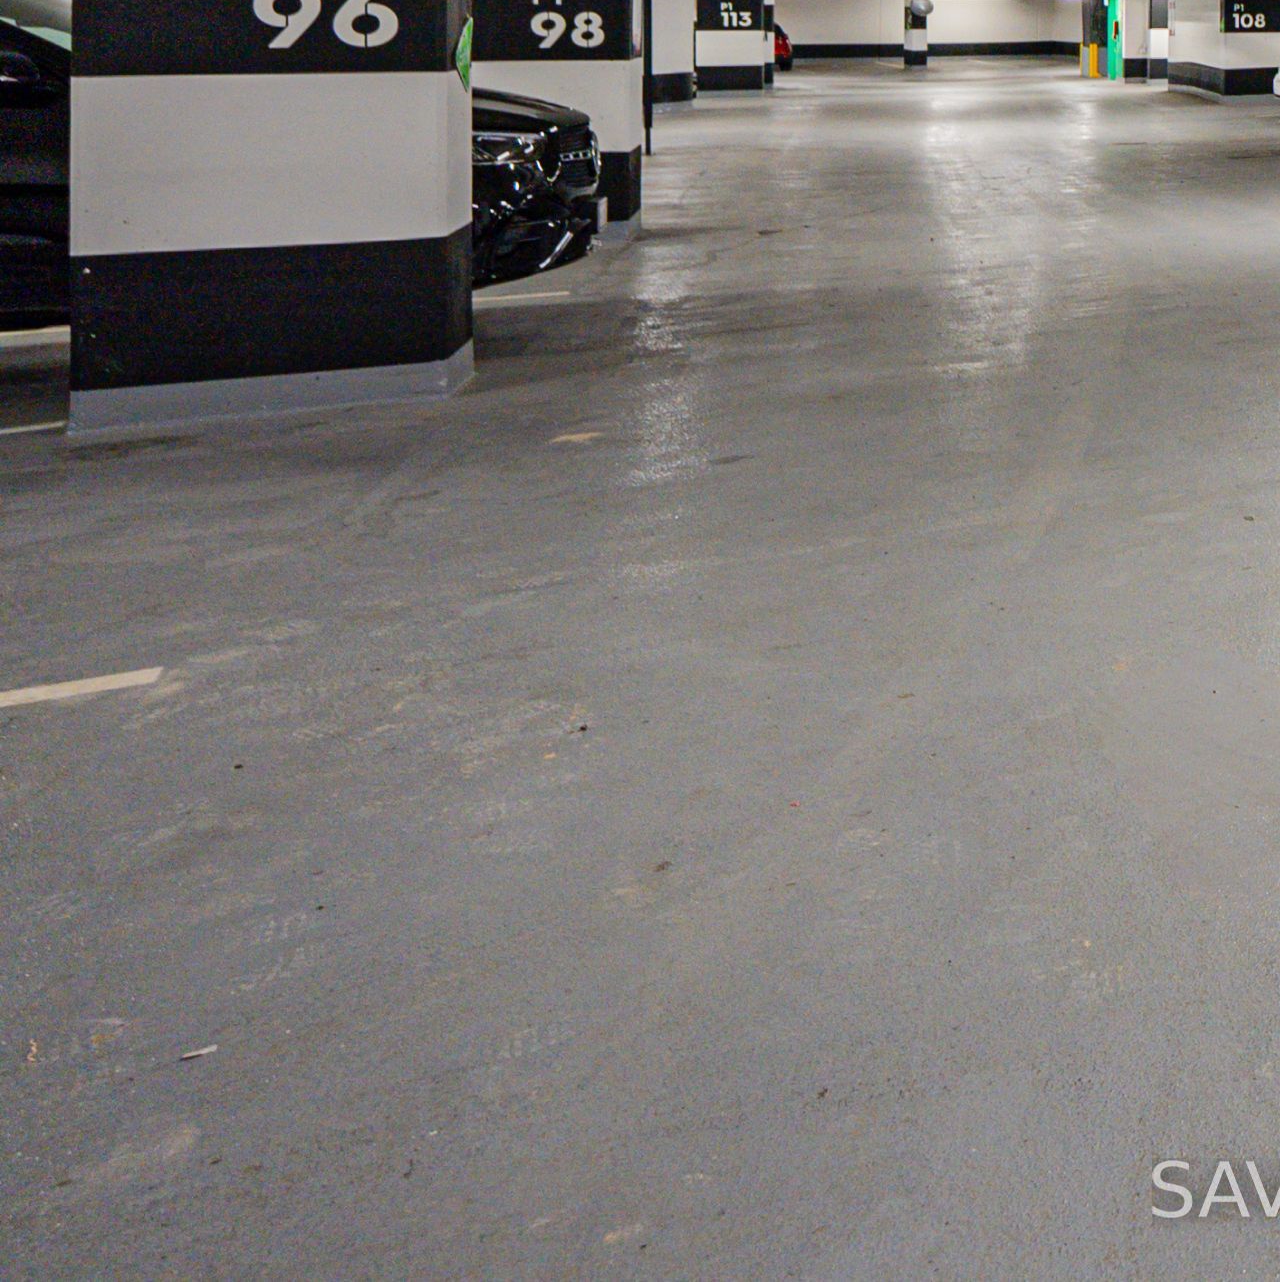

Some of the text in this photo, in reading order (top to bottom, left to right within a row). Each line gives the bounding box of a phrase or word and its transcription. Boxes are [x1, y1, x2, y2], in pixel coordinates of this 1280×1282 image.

[720, 1, 733, 11] P1
[1233, 3, 1245, 12] P1
[720, 11, 752, 28] 113
[1232, 13, 1266, 29] 108
[530, 11, 605, 49] 98
